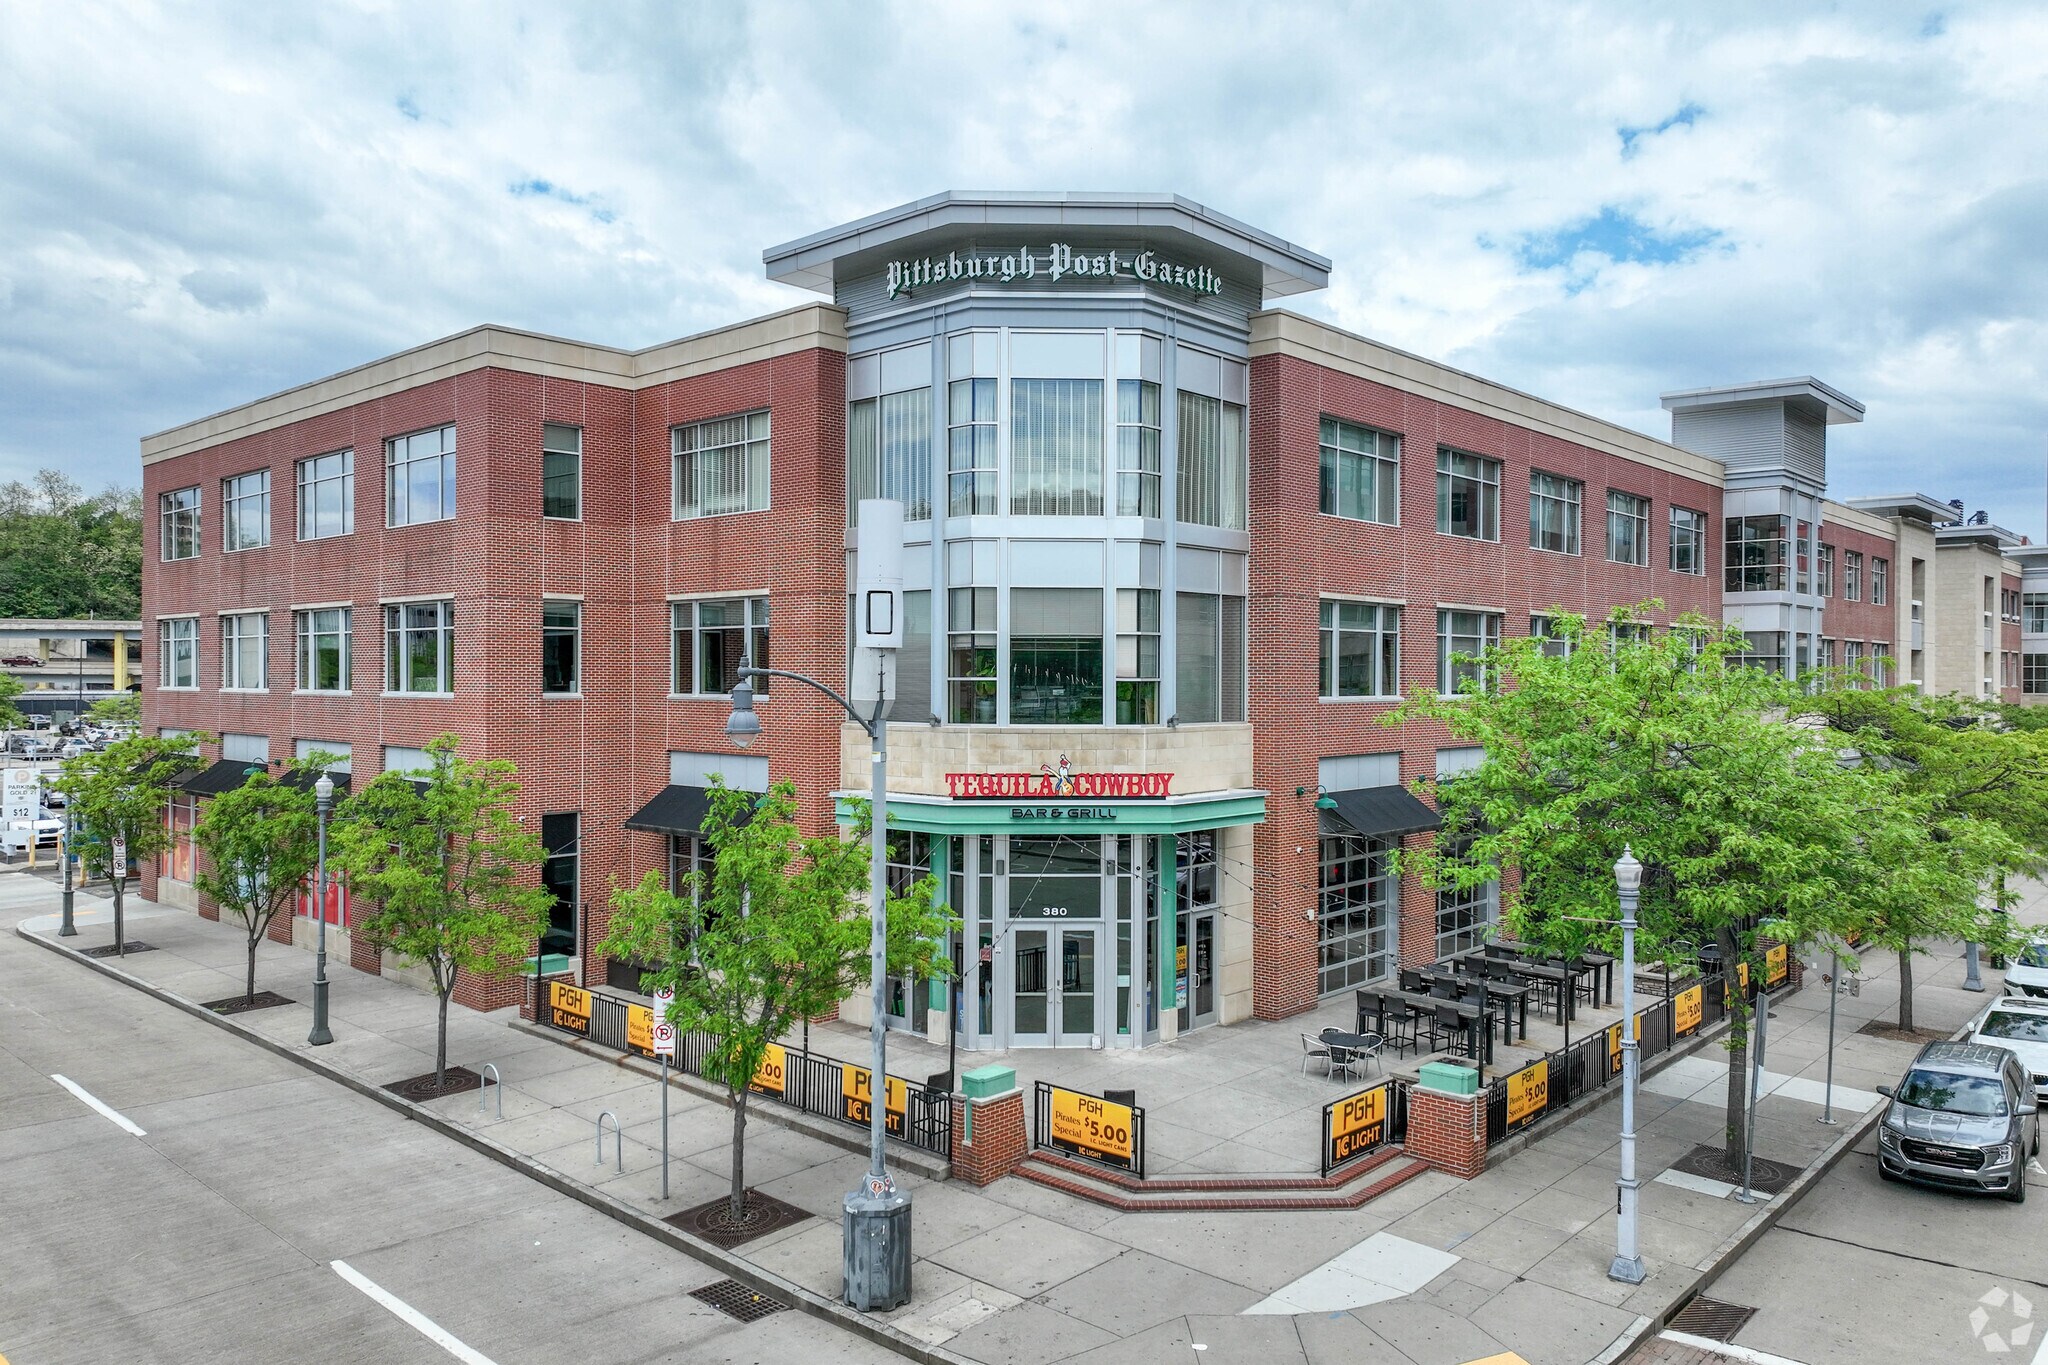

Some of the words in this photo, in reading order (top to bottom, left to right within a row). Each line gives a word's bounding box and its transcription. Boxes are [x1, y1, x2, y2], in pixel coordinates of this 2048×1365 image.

[886, 245, 1036, 300] Pittsburgh
[1049, 242, 1223, 296] Post-Gazette
[945, 773, 1052, 797] TEQUILA
[1074, 773, 1174, 797] COWBOY
[13, 808, 29, 816] $12
[1012, 809, 1047, 818] BAR
[1051, 809, 1063, 818] &
[1067, 809, 1117, 818] GRILL
[1042, 907, 1067, 916] 380
[558, 986, 583, 1012] PGH
[553, 1009, 563, 1025] IC
[564, 1013, 586, 1031] LIGHT
[643, 1010, 654, 1023] PG
[1522, 1069, 1535, 1087] PGH
[1525, 1081, 1546, 1103] $5.00
[848, 1099, 862, 1120] IC
[864, 1106, 899, 1130] LHT
[1055, 1111, 1081, 1125] Pirates
[1079, 1098, 1103, 1118] PGH
[1343, 1093, 1375, 1131] PGH
[1054, 1122, 1082, 1139] Special
[1084, 1116, 1127, 1144] $5.00
[1098, 1140, 1113, 1149] LIGHT
[1113, 1145, 1127, 1153] CANS
[1336, 1135, 1350, 1159] IC
[1351, 1125, 1381, 1150] LIGHT
[1086, 1149, 1102, 1159] LIGHT
